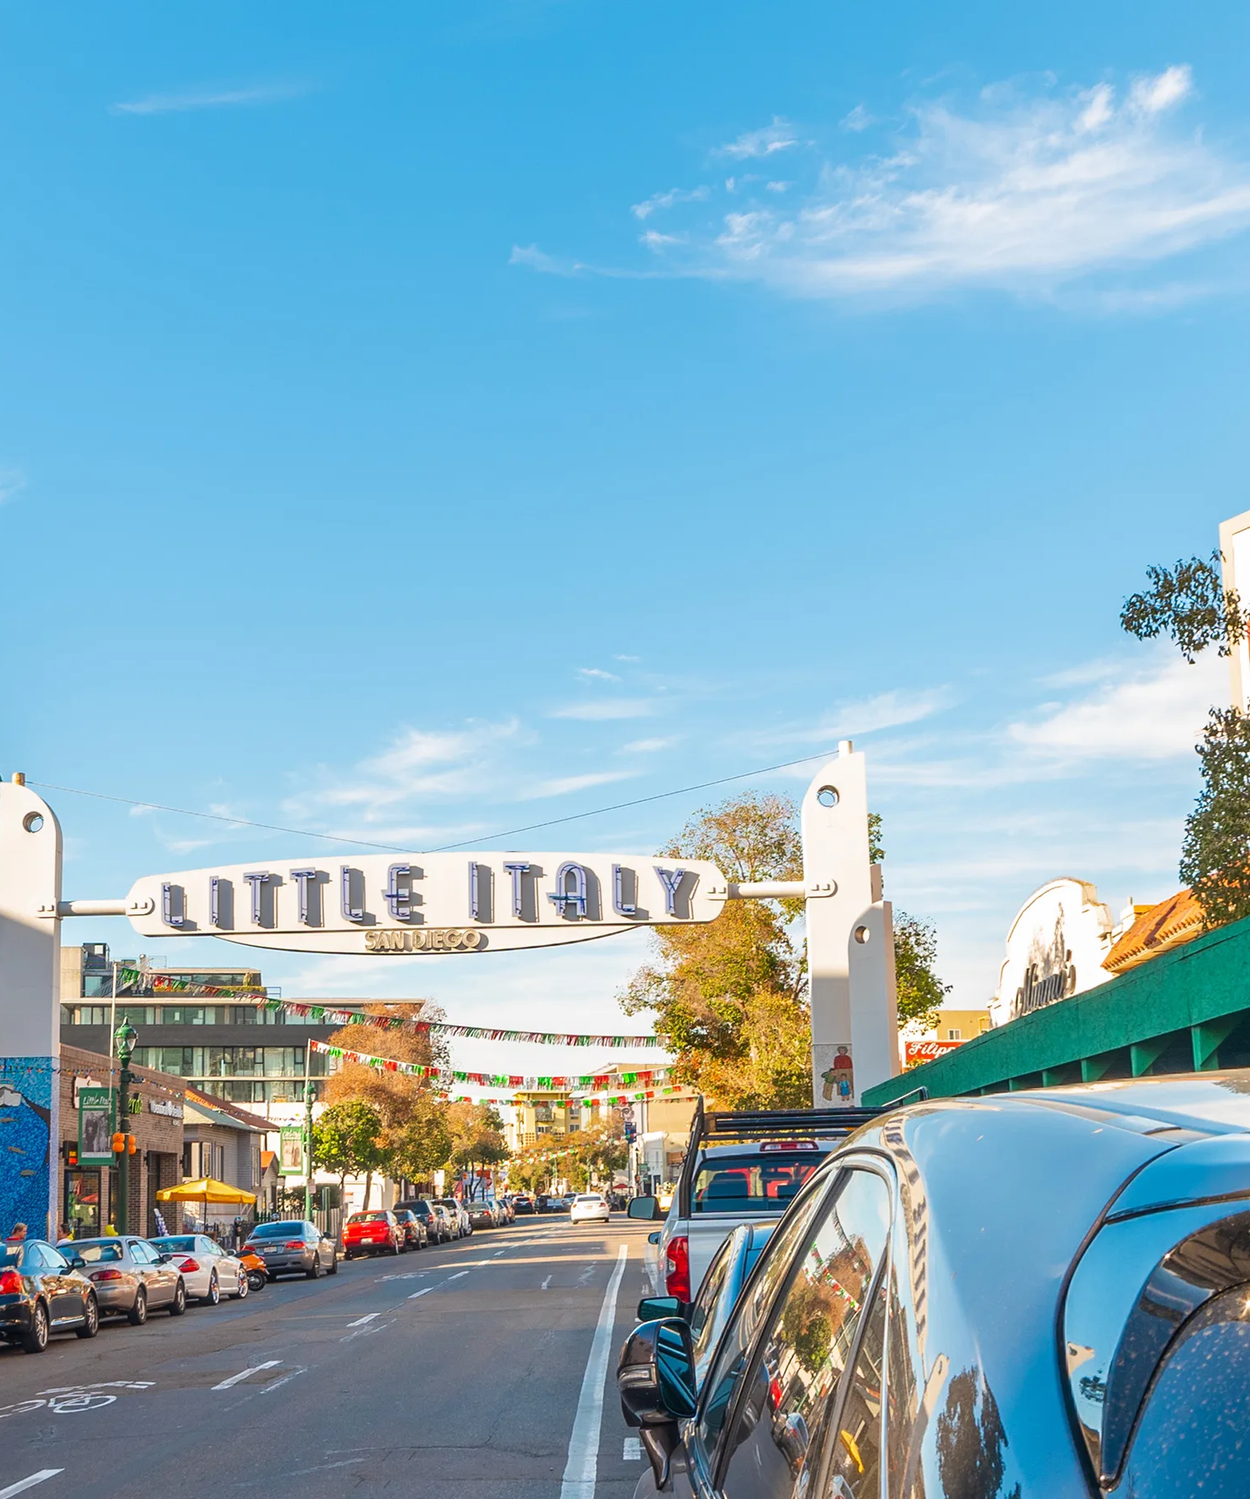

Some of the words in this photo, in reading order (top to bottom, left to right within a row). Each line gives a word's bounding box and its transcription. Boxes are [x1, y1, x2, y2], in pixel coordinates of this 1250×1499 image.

[161, 861, 411, 927] LITTLE
[467, 860, 687, 919] ITALY
[365, 930, 405, 951] SAN
[410, 928, 481, 949] DIEGO
[83, 1091, 100, 1106] Little
